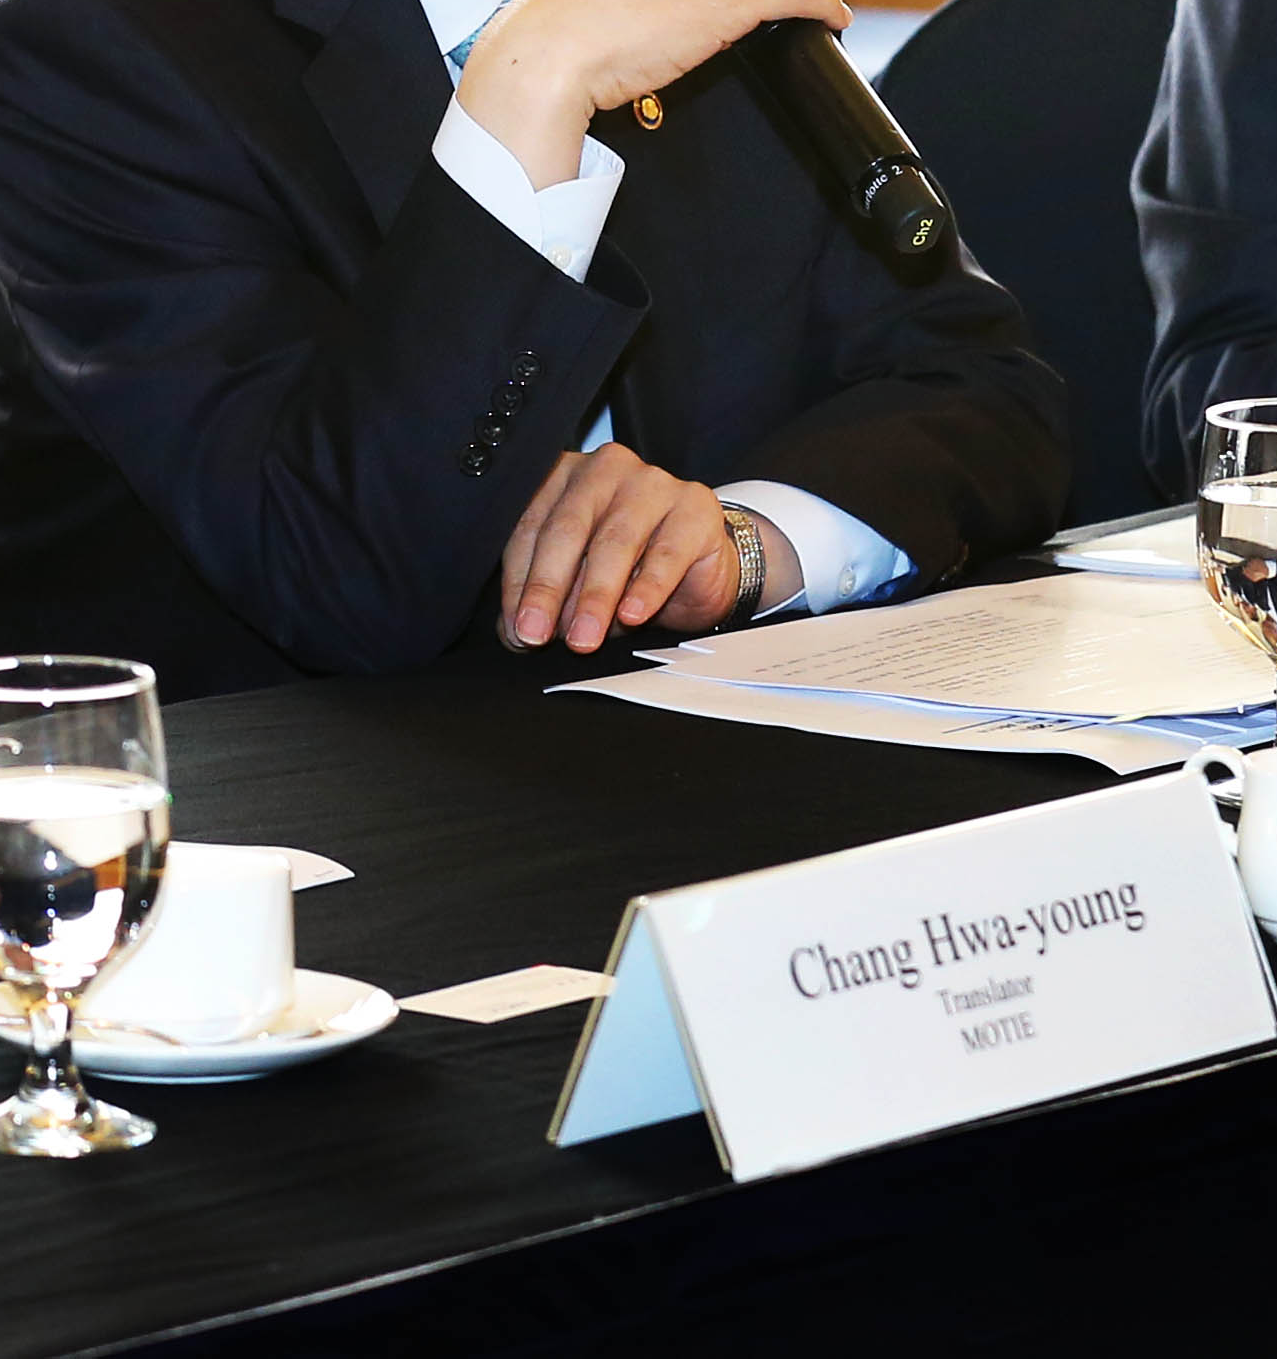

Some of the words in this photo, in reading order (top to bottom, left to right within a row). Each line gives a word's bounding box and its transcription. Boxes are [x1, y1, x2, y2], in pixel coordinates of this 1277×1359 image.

[891, 164, 904, 176] 2
[912, 218, 934, 246] Ch2
[789, 939, 921, 1000] Chang
[921, 882, 1146, 967] Hwa-young
[936, 974, 1035, 1017] Translator
[960, 1011, 1037, 1054] MOTIE
